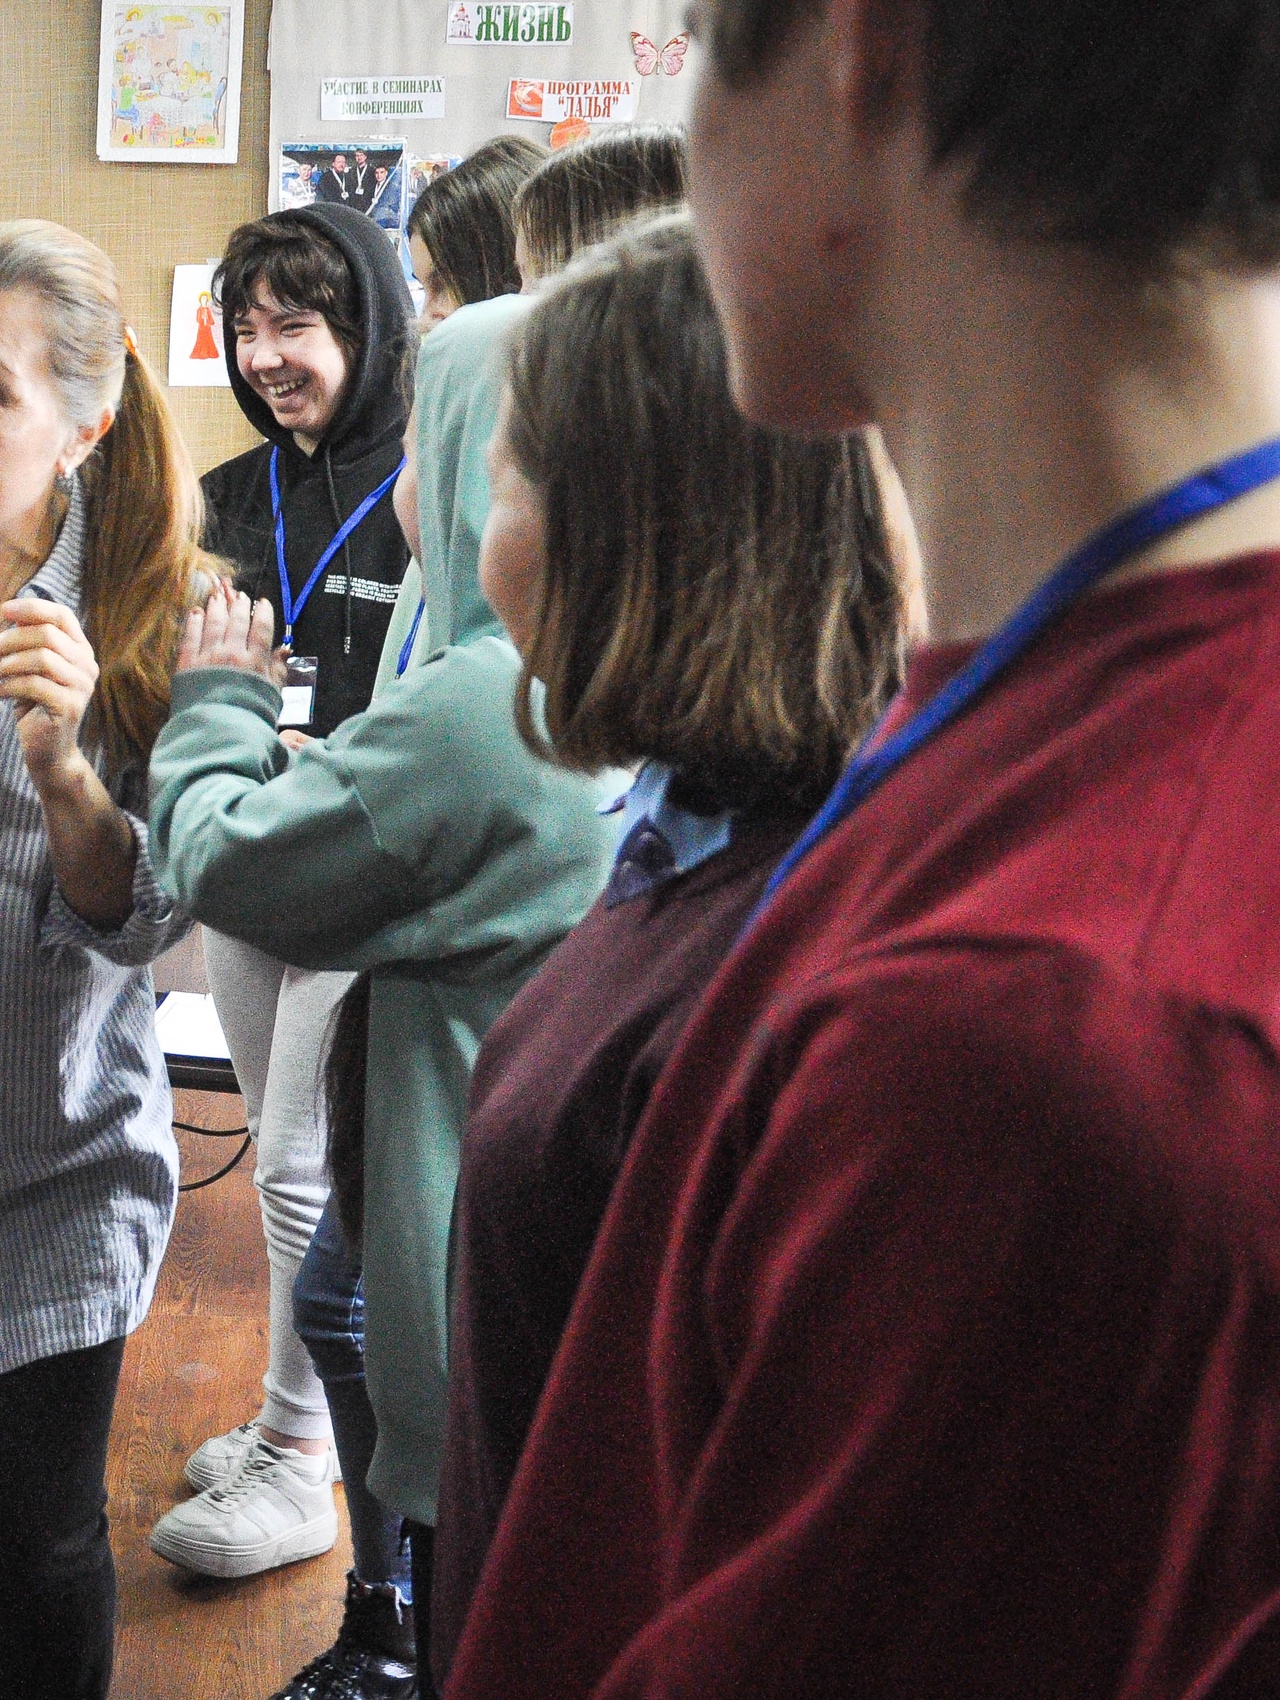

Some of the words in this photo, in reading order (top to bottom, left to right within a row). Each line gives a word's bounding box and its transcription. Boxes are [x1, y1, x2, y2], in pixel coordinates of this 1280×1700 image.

[475, 4, 571, 42] ЖИЗНЬ
[324, 80, 369, 96] УЧАСТИЕ
[372, 81, 379, 94] В
[382, 79, 443, 94] СЕМИНАРАХ
[547, 81, 631, 95] ПРОГРАММА
